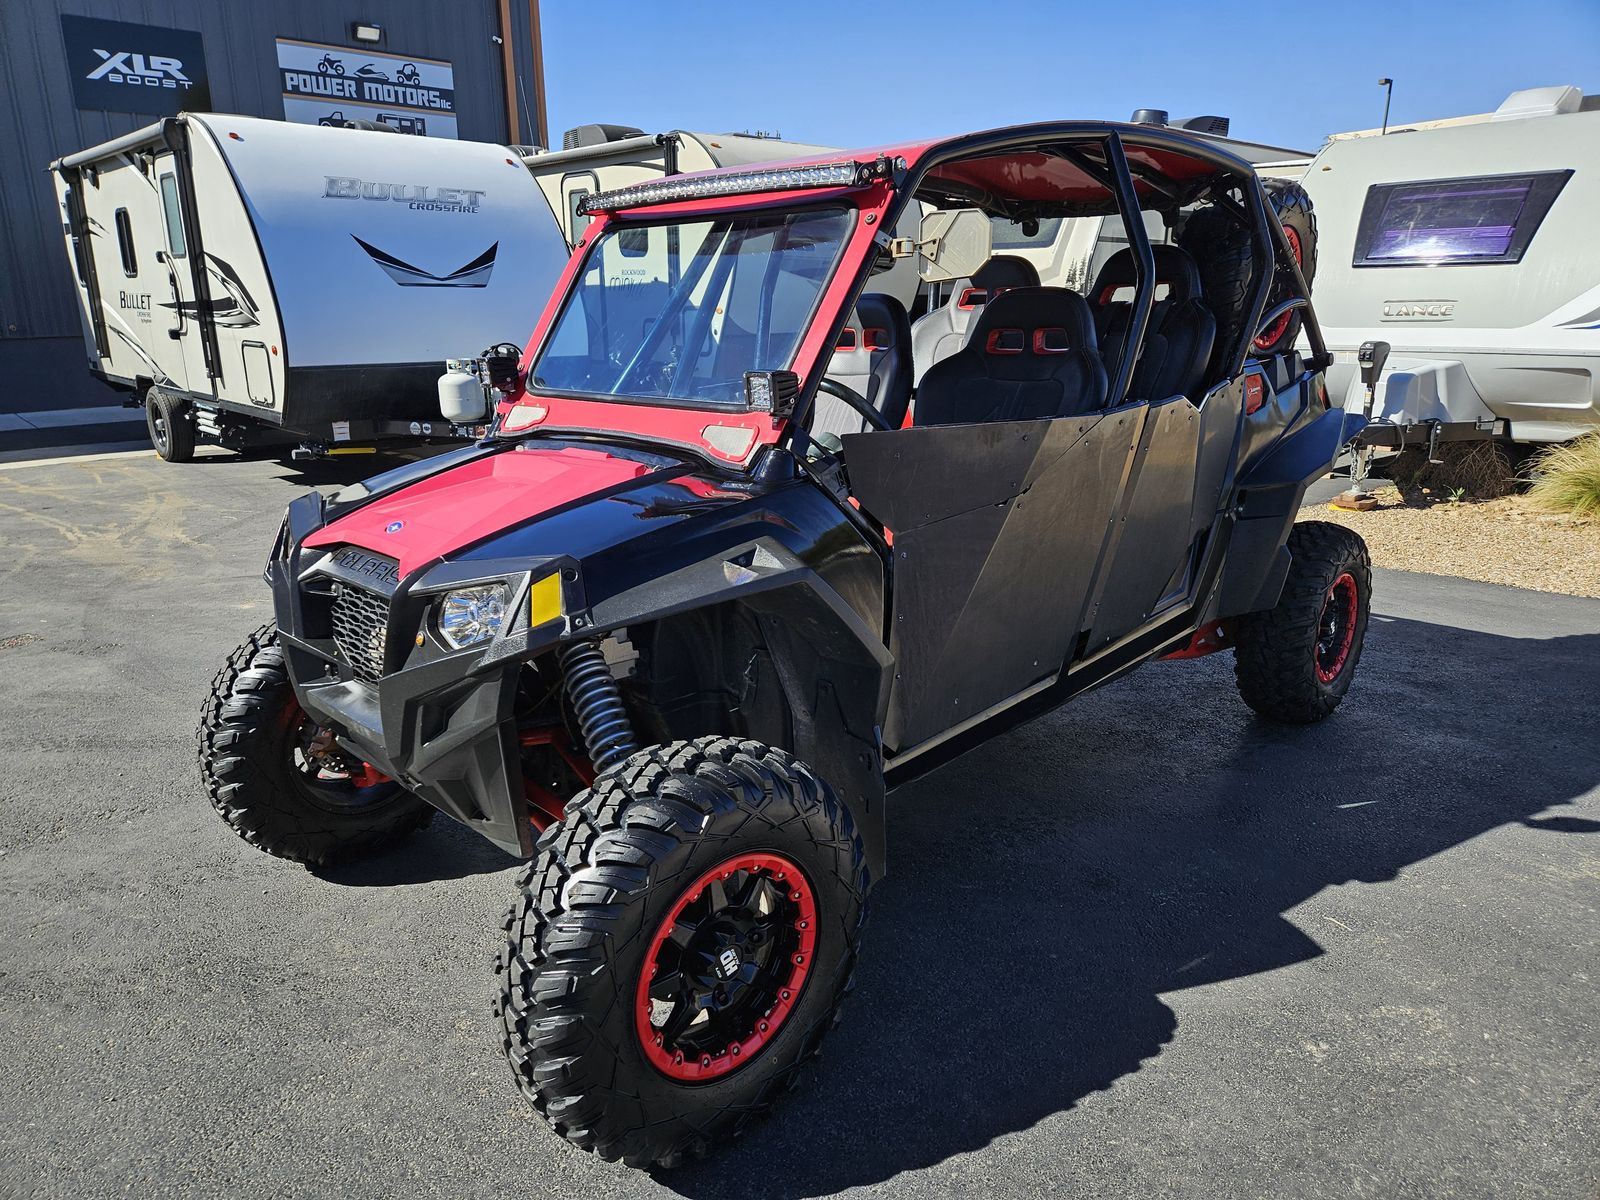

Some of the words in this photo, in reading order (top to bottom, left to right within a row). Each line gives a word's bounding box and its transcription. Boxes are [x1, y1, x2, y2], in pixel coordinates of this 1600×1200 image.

[86, 49, 189, 80] XLR
[108, 73, 193, 90] BOOST
[285, 72, 358, 98] POWER
[364, 82, 440, 109] MOTORS
[321, 176, 486, 207] BULLET
[409, 202, 479, 214] CROSSFIRE
[120, 290, 151, 310] BULLET
[1383, 304, 1455, 317] LANCE
[329, 548, 400, 586] POLARIS
